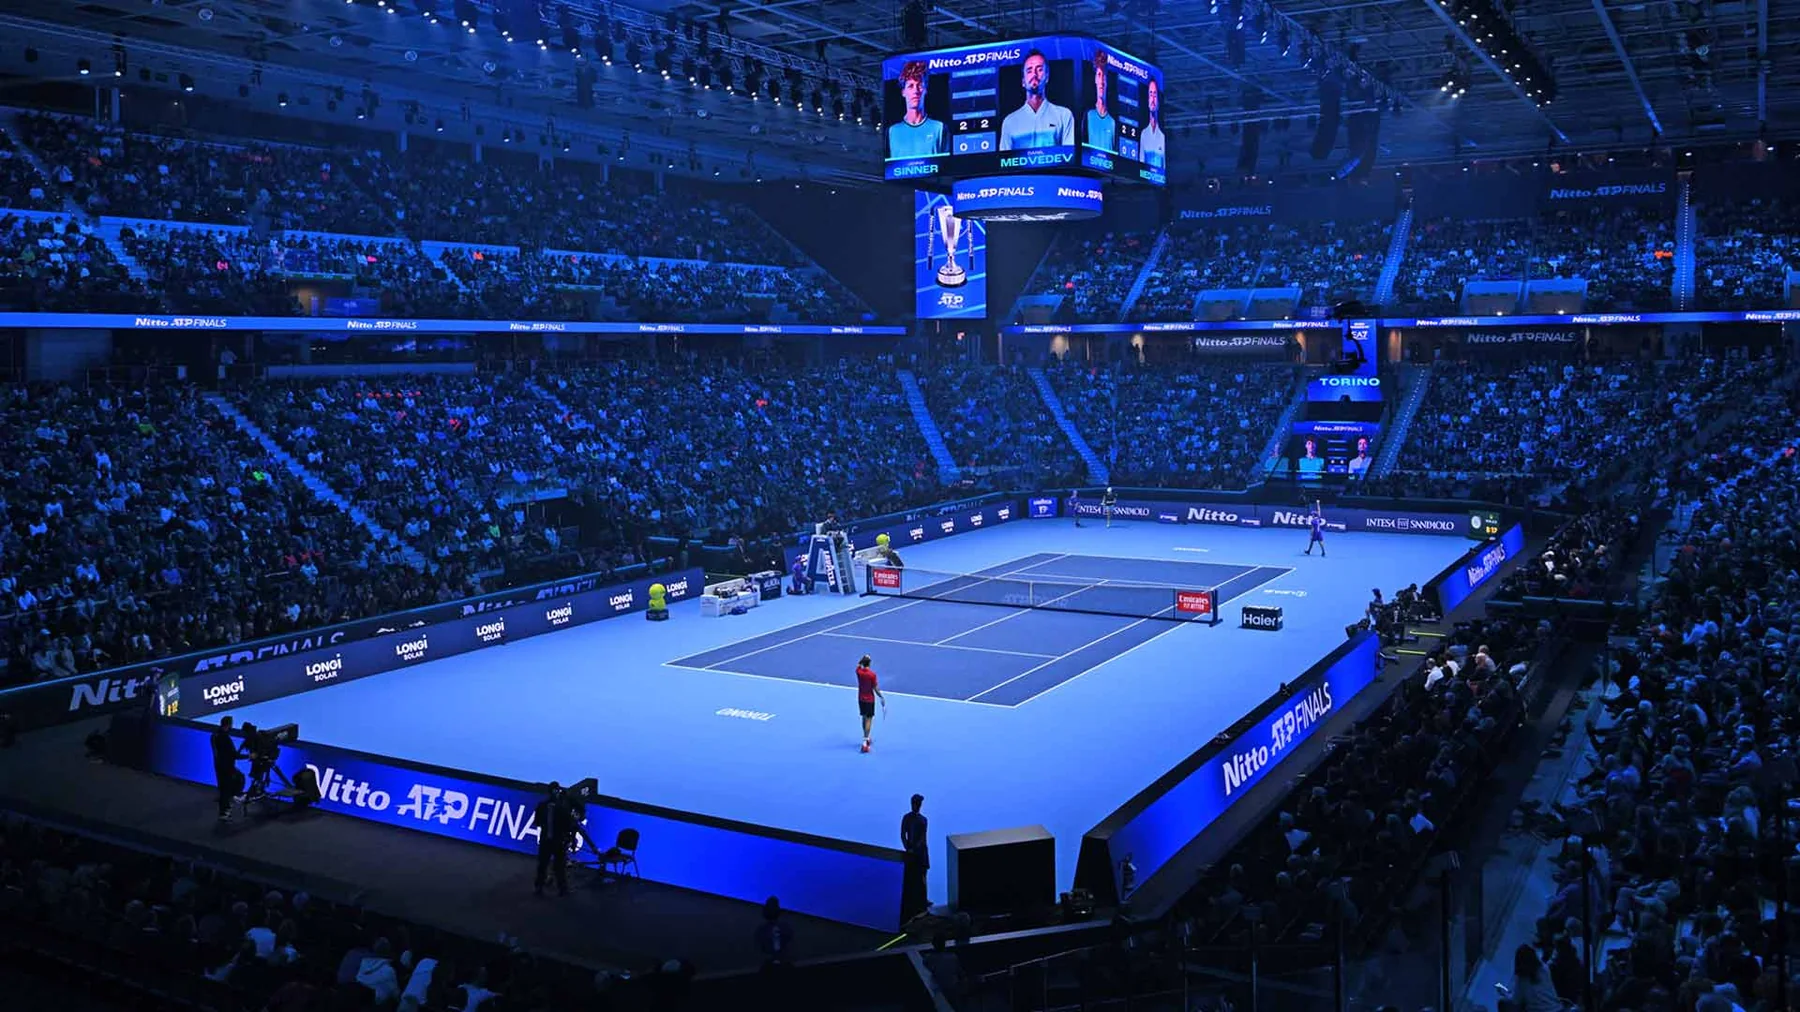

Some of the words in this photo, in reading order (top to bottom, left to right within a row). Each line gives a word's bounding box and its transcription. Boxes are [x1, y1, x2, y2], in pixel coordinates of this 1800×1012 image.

[929, 58, 961, 69] Nitto
[963, 53, 986, 65] ATP
[986, 49, 1020, 61] FINALS
[960, 121, 967, 130] 2
[981, 119, 989, 128] 2
[1122, 125, 1126, 134] 2
[1131, 128, 1136, 136] 2
[960, 143, 968, 151] 0
[981, 141, 989, 149] 0
[1000, 153, 1073, 168] MEDVEDEV
[894, 164, 938, 176] SINNER
[957, 191, 976, 201] Nitto
[977, 189, 998, 198] ATP
[998, 186, 1034, 197] FINALS
[1058, 187, 1085, 198] Nitto
[1550, 189, 1591, 199] Nitto
[1622, 183, 1666, 194] FINALS
[135, 318, 169, 326] Nitto
[170, 318, 193, 327] ATP
[193, 318, 227, 328] FINALS
[347, 320, 372, 329] Nitto
[1196, 337, 1228, 346] Nitto
[1228, 337, 1252, 346] ATP
[1251, 336, 1285, 346] FINALS
[1468, 333, 1505, 343] Nitto
[1535, 332, 1575, 342] FINALS
[1320, 377, 1380, 386] TORINO
[1079, 505, 1101, 514] NTESA
[1187, 508, 1238, 522] Nitto
[1366, 518, 1396, 528] INTESA
[1243, 613, 1277, 626] Haier
[404, 651, 424, 661] SOLAR
[314, 670, 337, 682] SOLAR
[213, 694, 239, 706] SOLAR
[1222, 744, 1268, 796] Nitto
[1270, 711, 1296, 757] ATP
[1295, 682, 1332, 734] FINALS
[305, 763, 391, 811] Nitto
[397, 783, 469, 825] ATP
